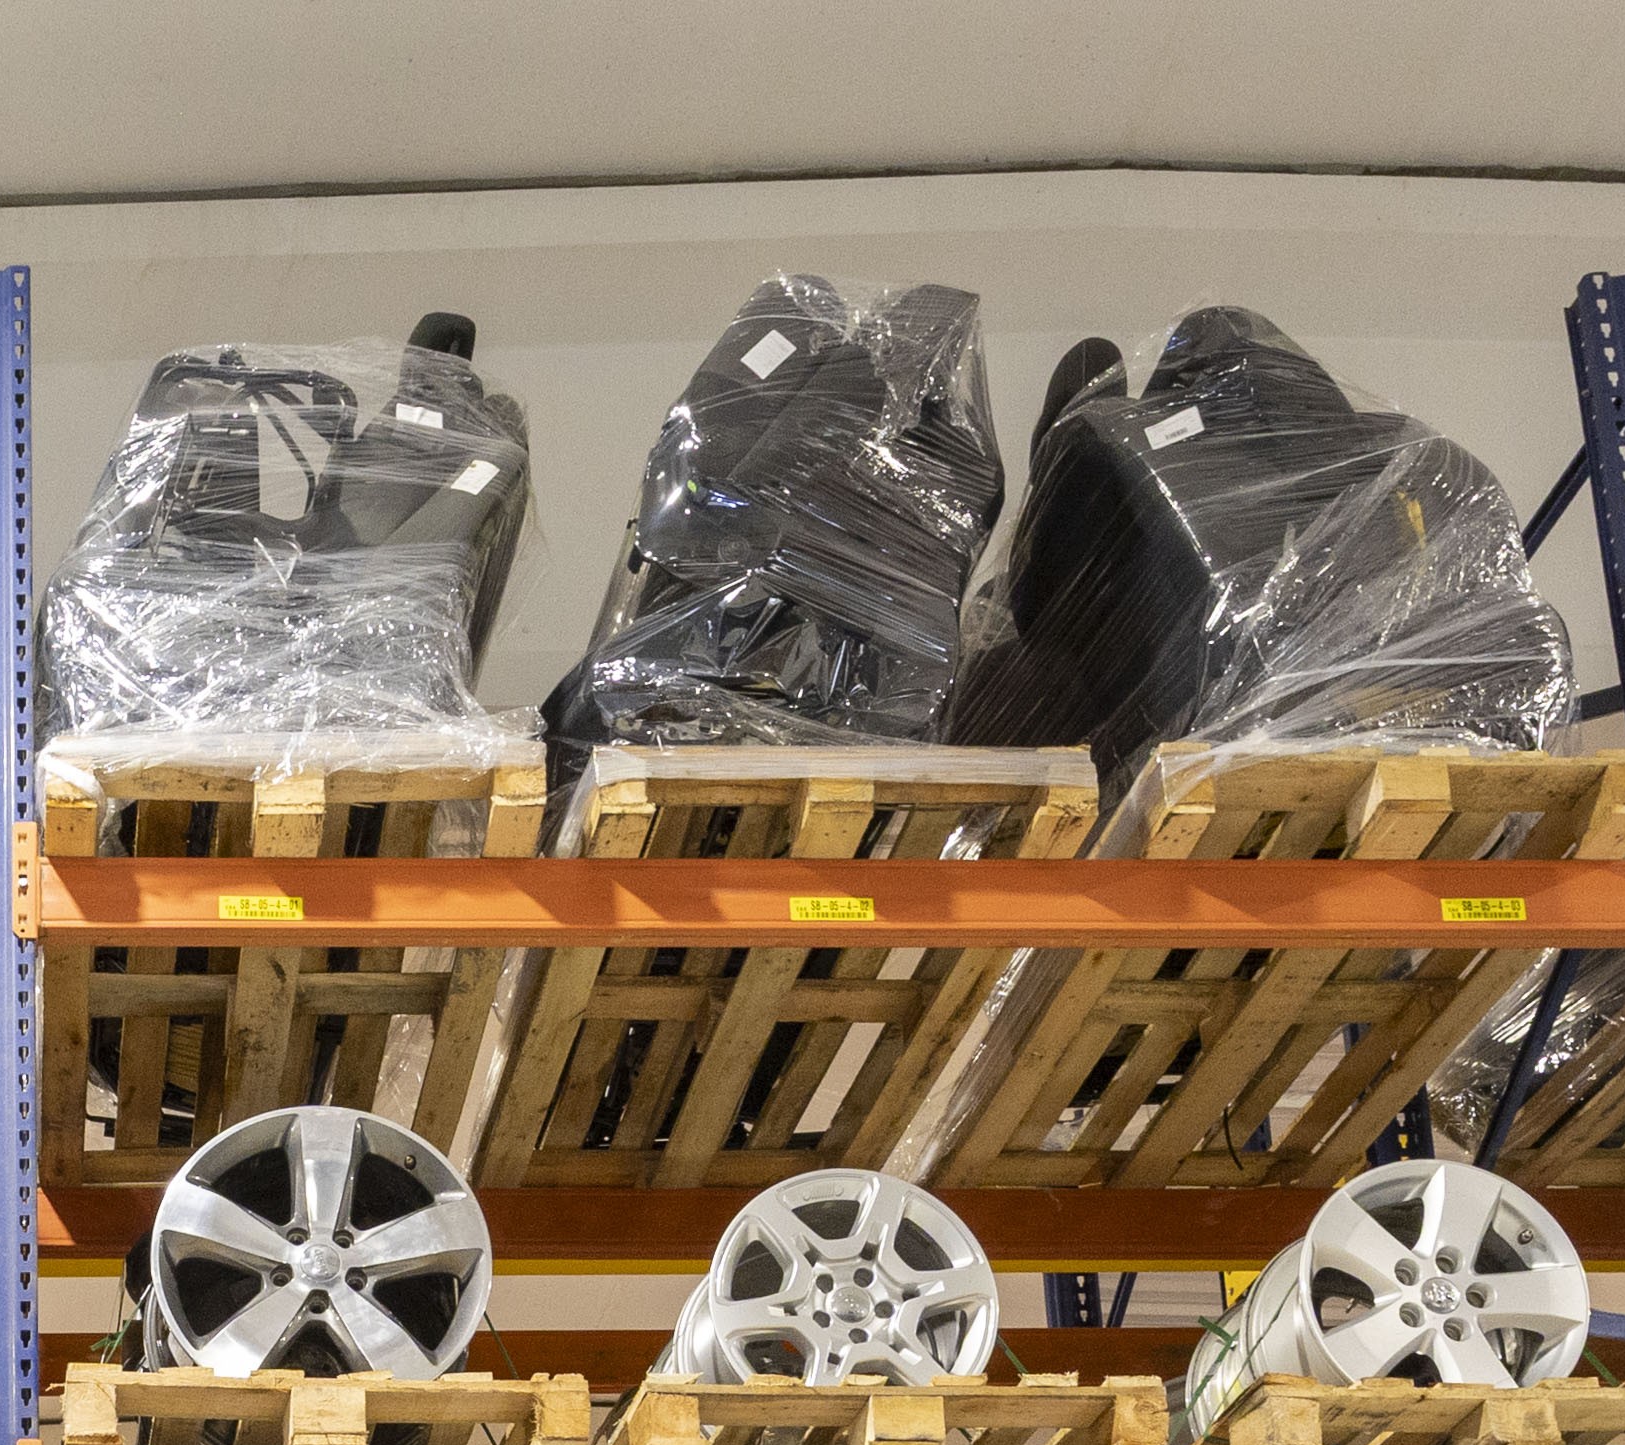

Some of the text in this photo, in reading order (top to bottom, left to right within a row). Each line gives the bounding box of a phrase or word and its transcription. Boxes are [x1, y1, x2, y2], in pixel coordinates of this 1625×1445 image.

[239, 898, 300, 911] SB-05-4-01
[810, 899, 870, 912] SB-05-4-02
[1461, 900, 1522, 912] SB-05-4-03
